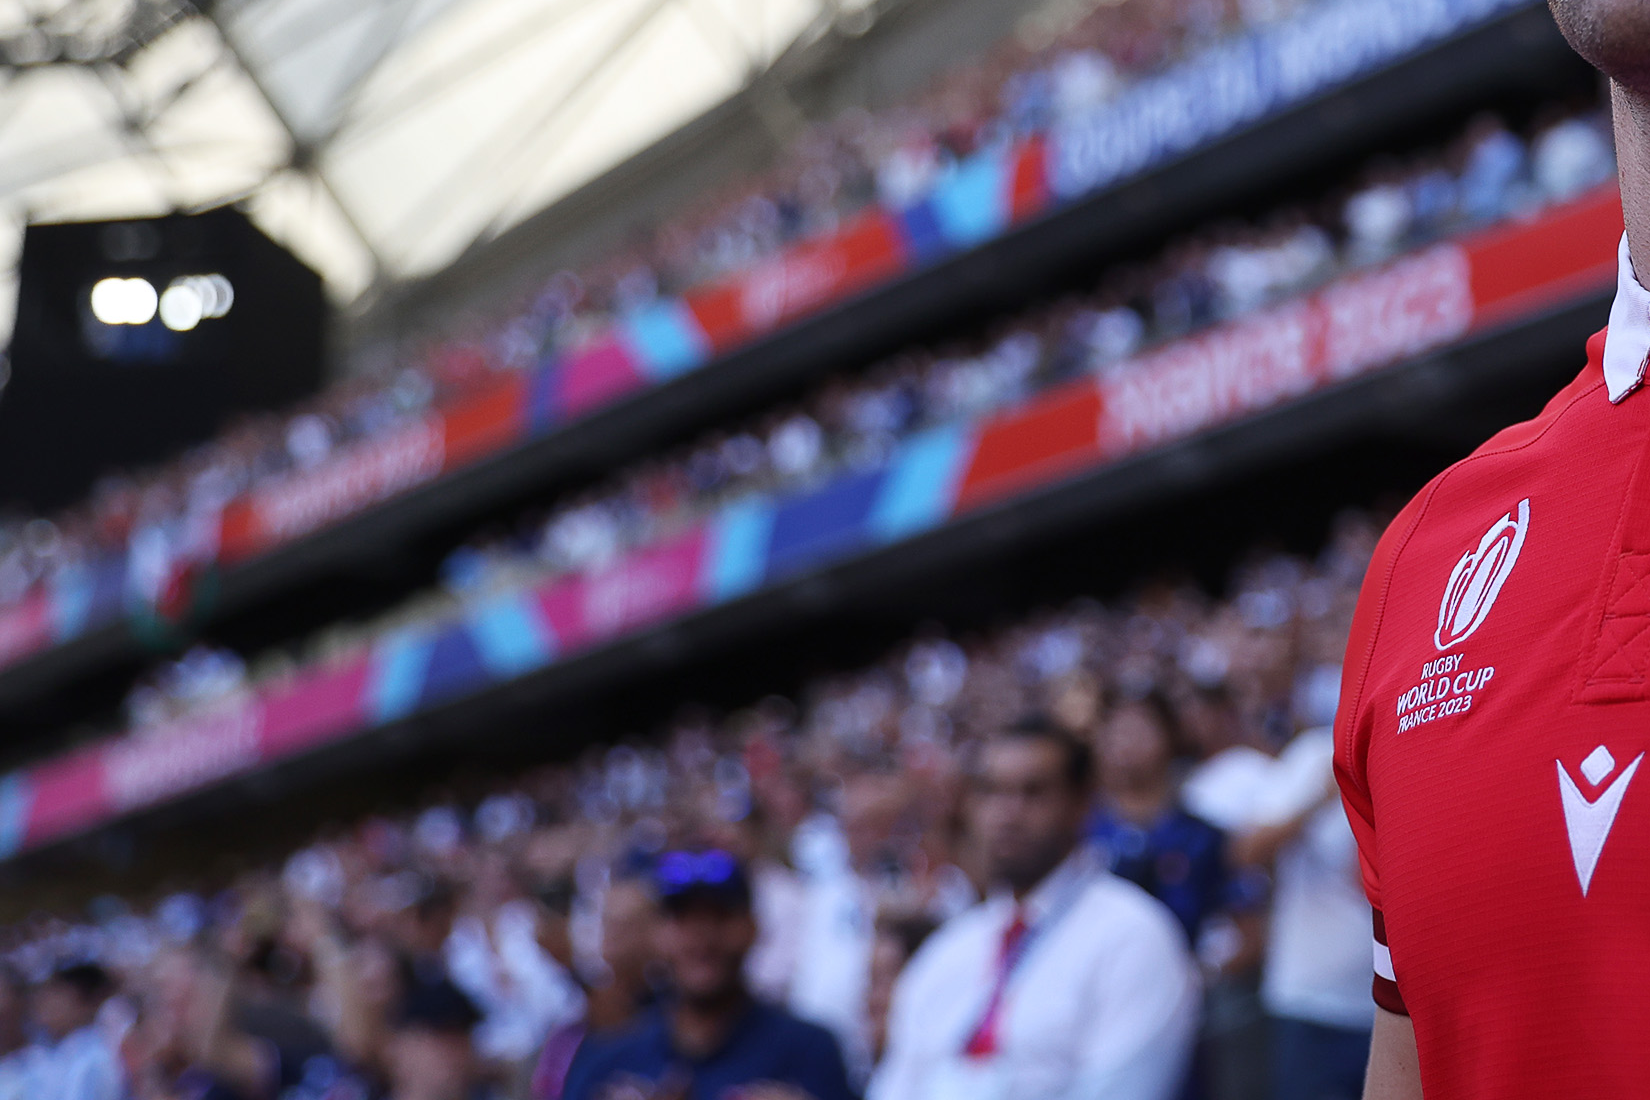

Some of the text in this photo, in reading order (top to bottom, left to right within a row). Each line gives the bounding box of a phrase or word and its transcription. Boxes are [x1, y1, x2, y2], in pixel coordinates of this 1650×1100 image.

[1421, 653, 1464, 680] RUGBY
[1396, 666, 1495, 716] WORLD CUP
[1397, 695, 1473, 734] FRANCE 2023
